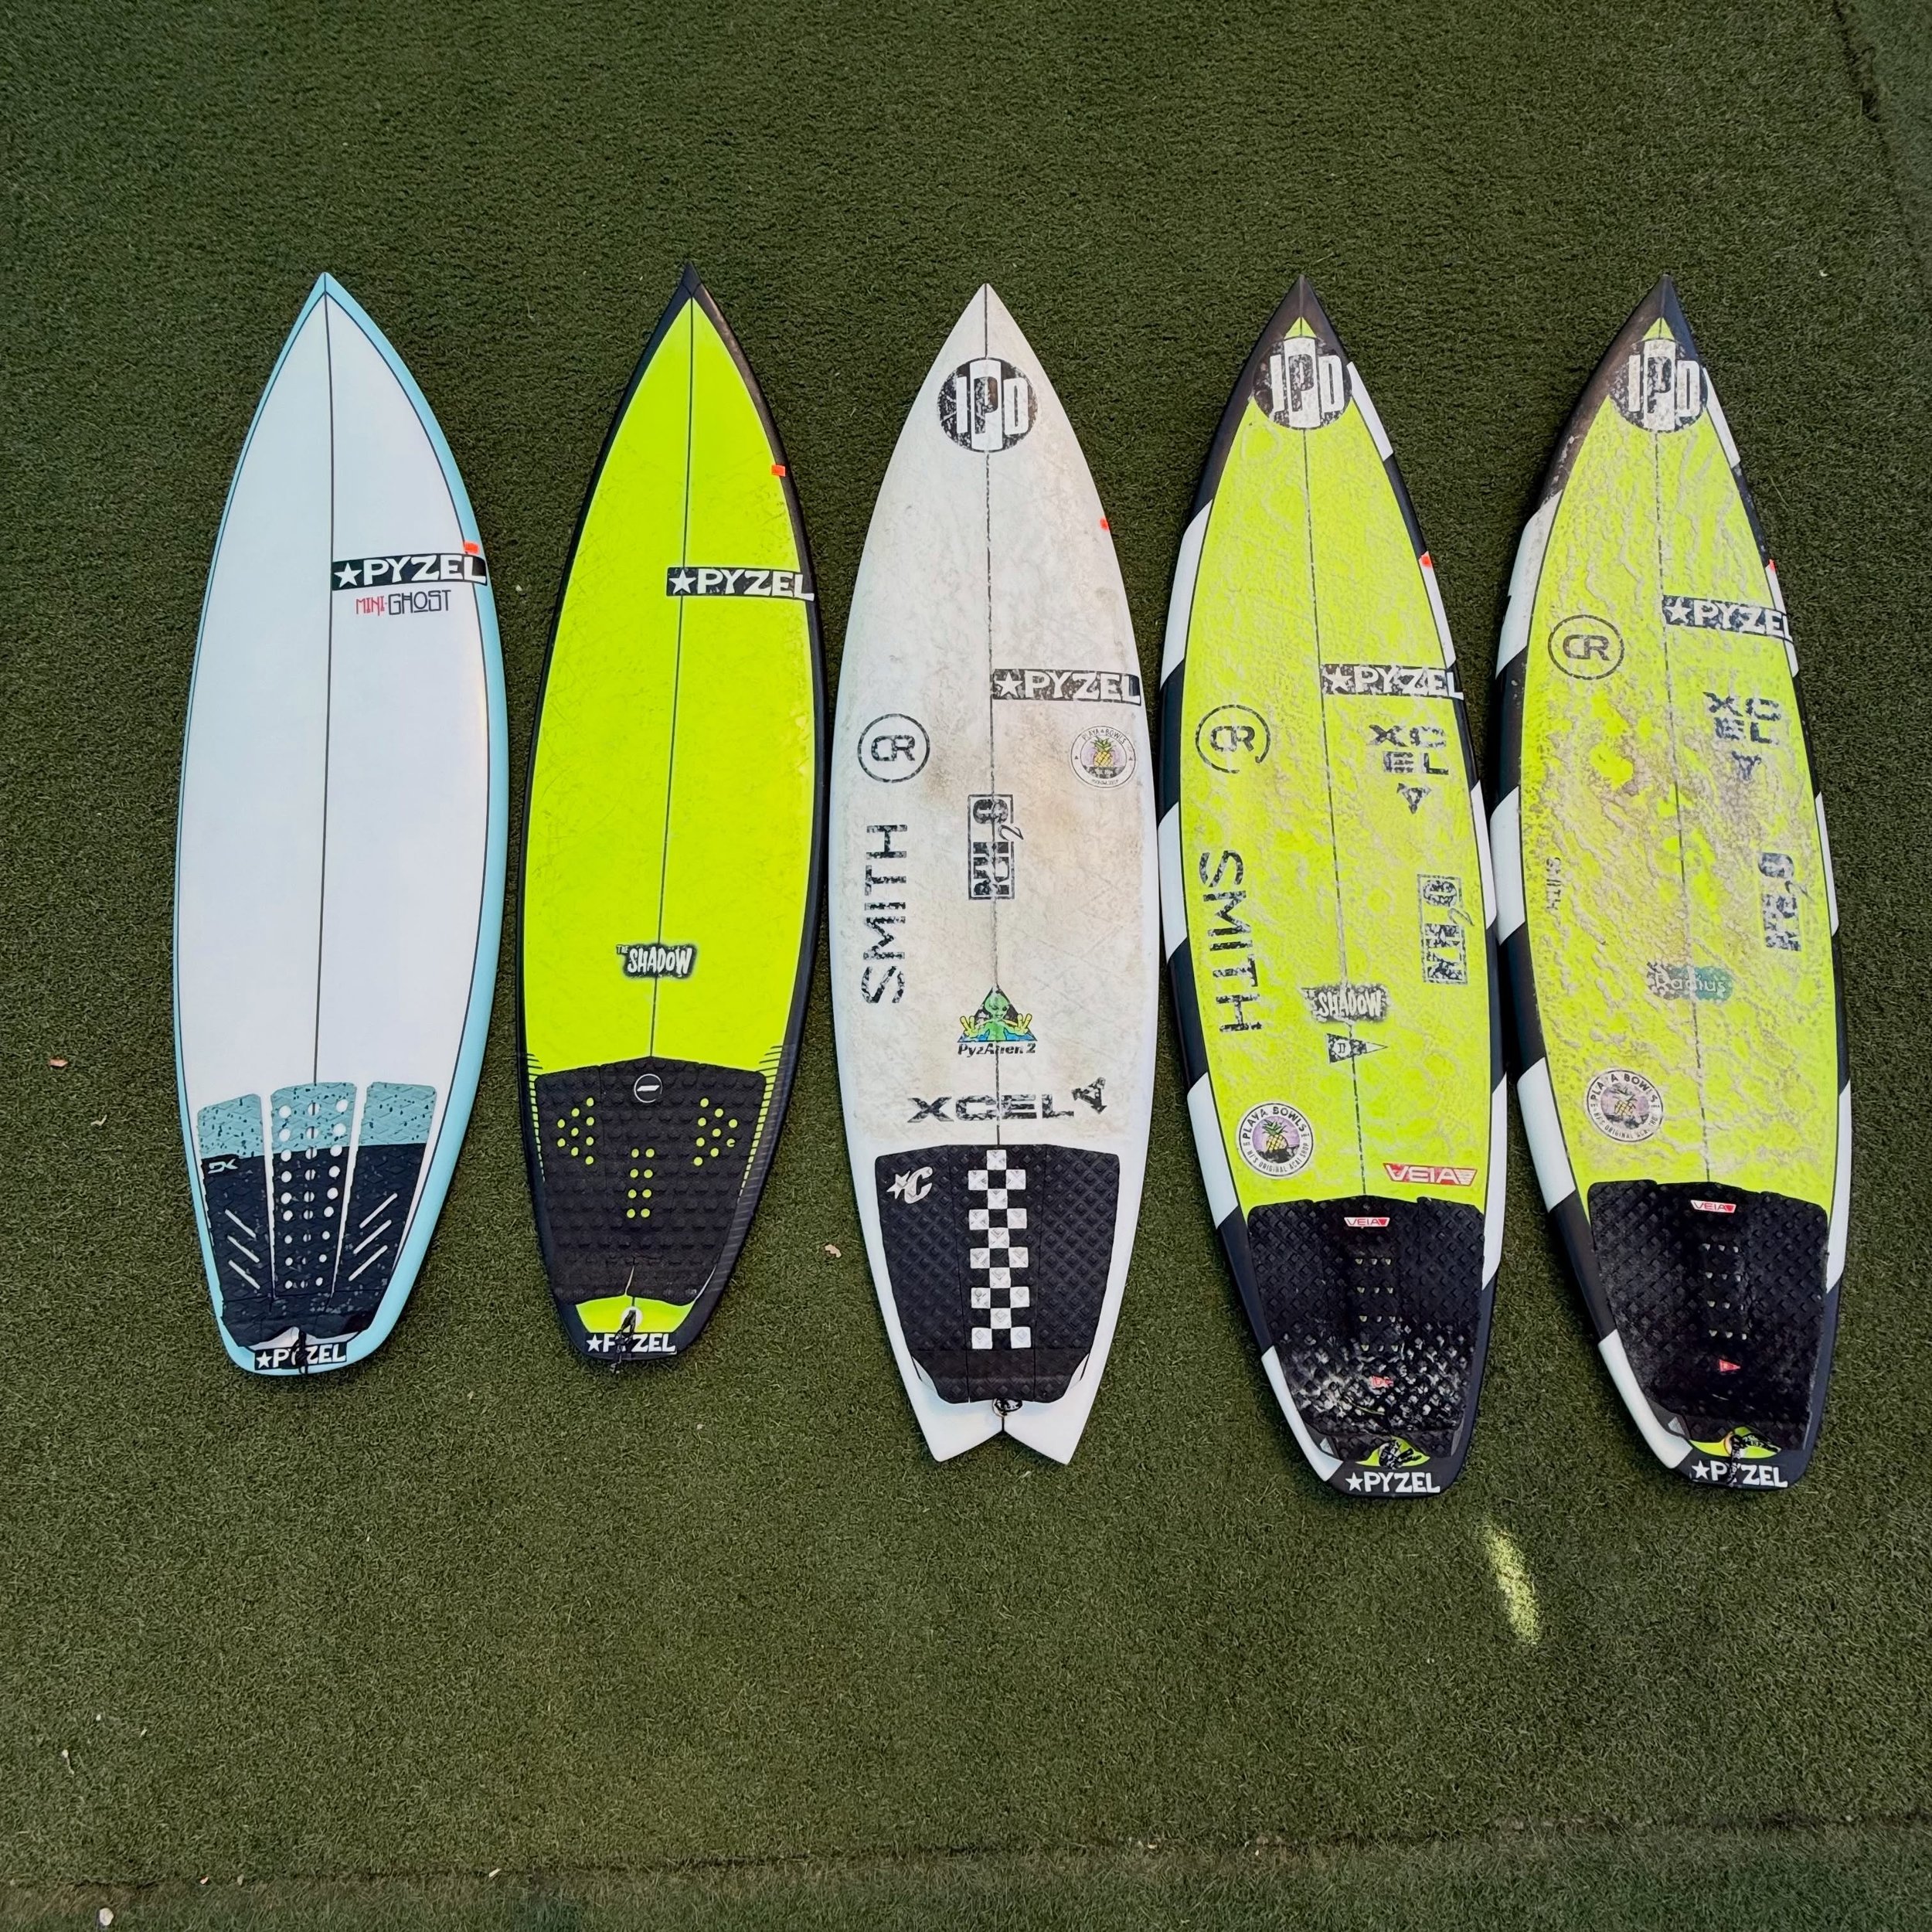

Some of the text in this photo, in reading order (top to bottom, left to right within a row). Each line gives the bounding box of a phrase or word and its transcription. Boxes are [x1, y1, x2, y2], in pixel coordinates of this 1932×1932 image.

[363, 555, 487, 586] PYZEL
[697, 568, 815, 601] PYZEL
[1693, 600, 1793, 641] PYZEL
[1025, 670, 1141, 705] PYZEL
[1355, 667, 1464, 701] PYZEL
[861, 824, 908, 1005] SMITH
[1199, 849, 1262, 1032] SMITH
[628, 946, 692, 975] SHADOW
[1318, 987, 1382, 1017] SHADOW
[1590, 1073, 1658, 1103] PLAA BOWS
[907, 1094, 1074, 1123] XCEL
[1243, 1107, 1307, 1139] PLAYA BOWLS
[603, 1333, 676, 1353] PZEL
[1364, 1471, 1440, 1494] PYZEL
[1710, 1460, 1788, 1488] PZEL
